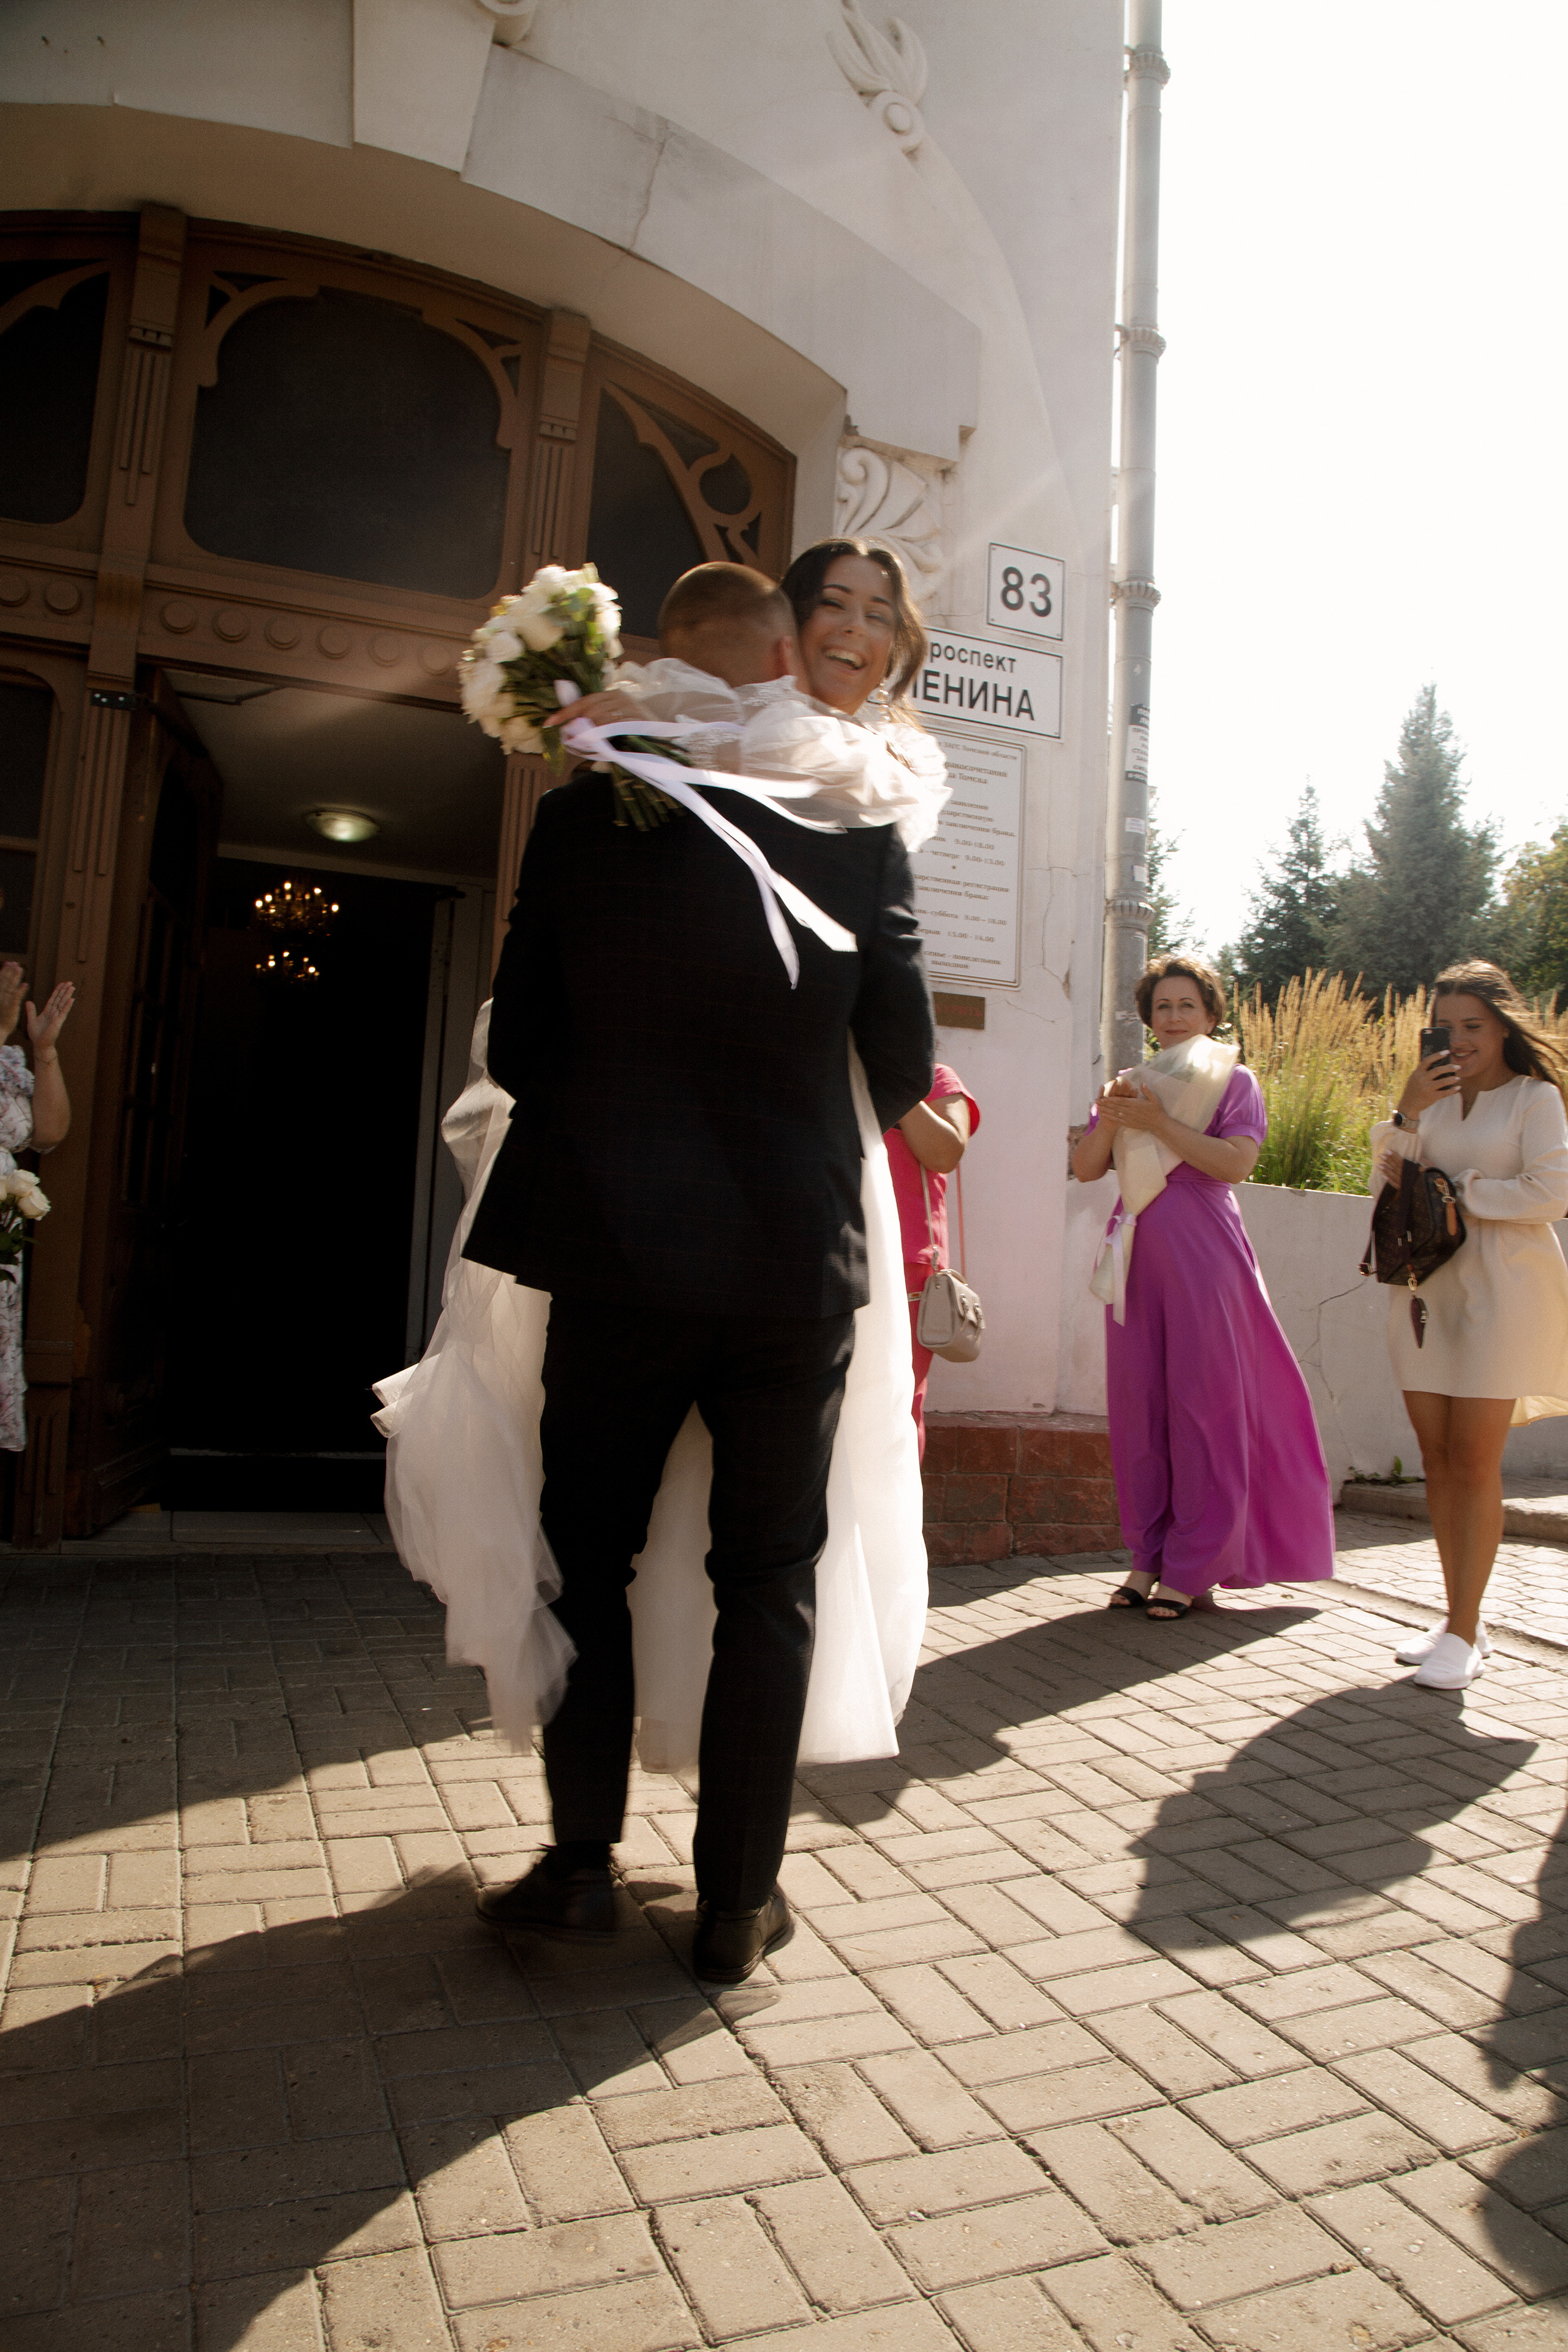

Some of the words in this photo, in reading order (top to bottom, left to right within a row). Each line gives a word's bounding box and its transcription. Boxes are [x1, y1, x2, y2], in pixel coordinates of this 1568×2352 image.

[1000, 567, 1052, 617] 83
[930, 641, 1017, 673] роспект
[943, 741, 960, 750] ЗАГС
[991, 751, 1017, 761] области
[959, 772, 987, 784] Томска
[940, 809, 993, 823] ударственную
[930, 850, 960, 860] четверг
[913, 874, 960, 886] дарственная
[952, 954, 1001, 965] понедельник
